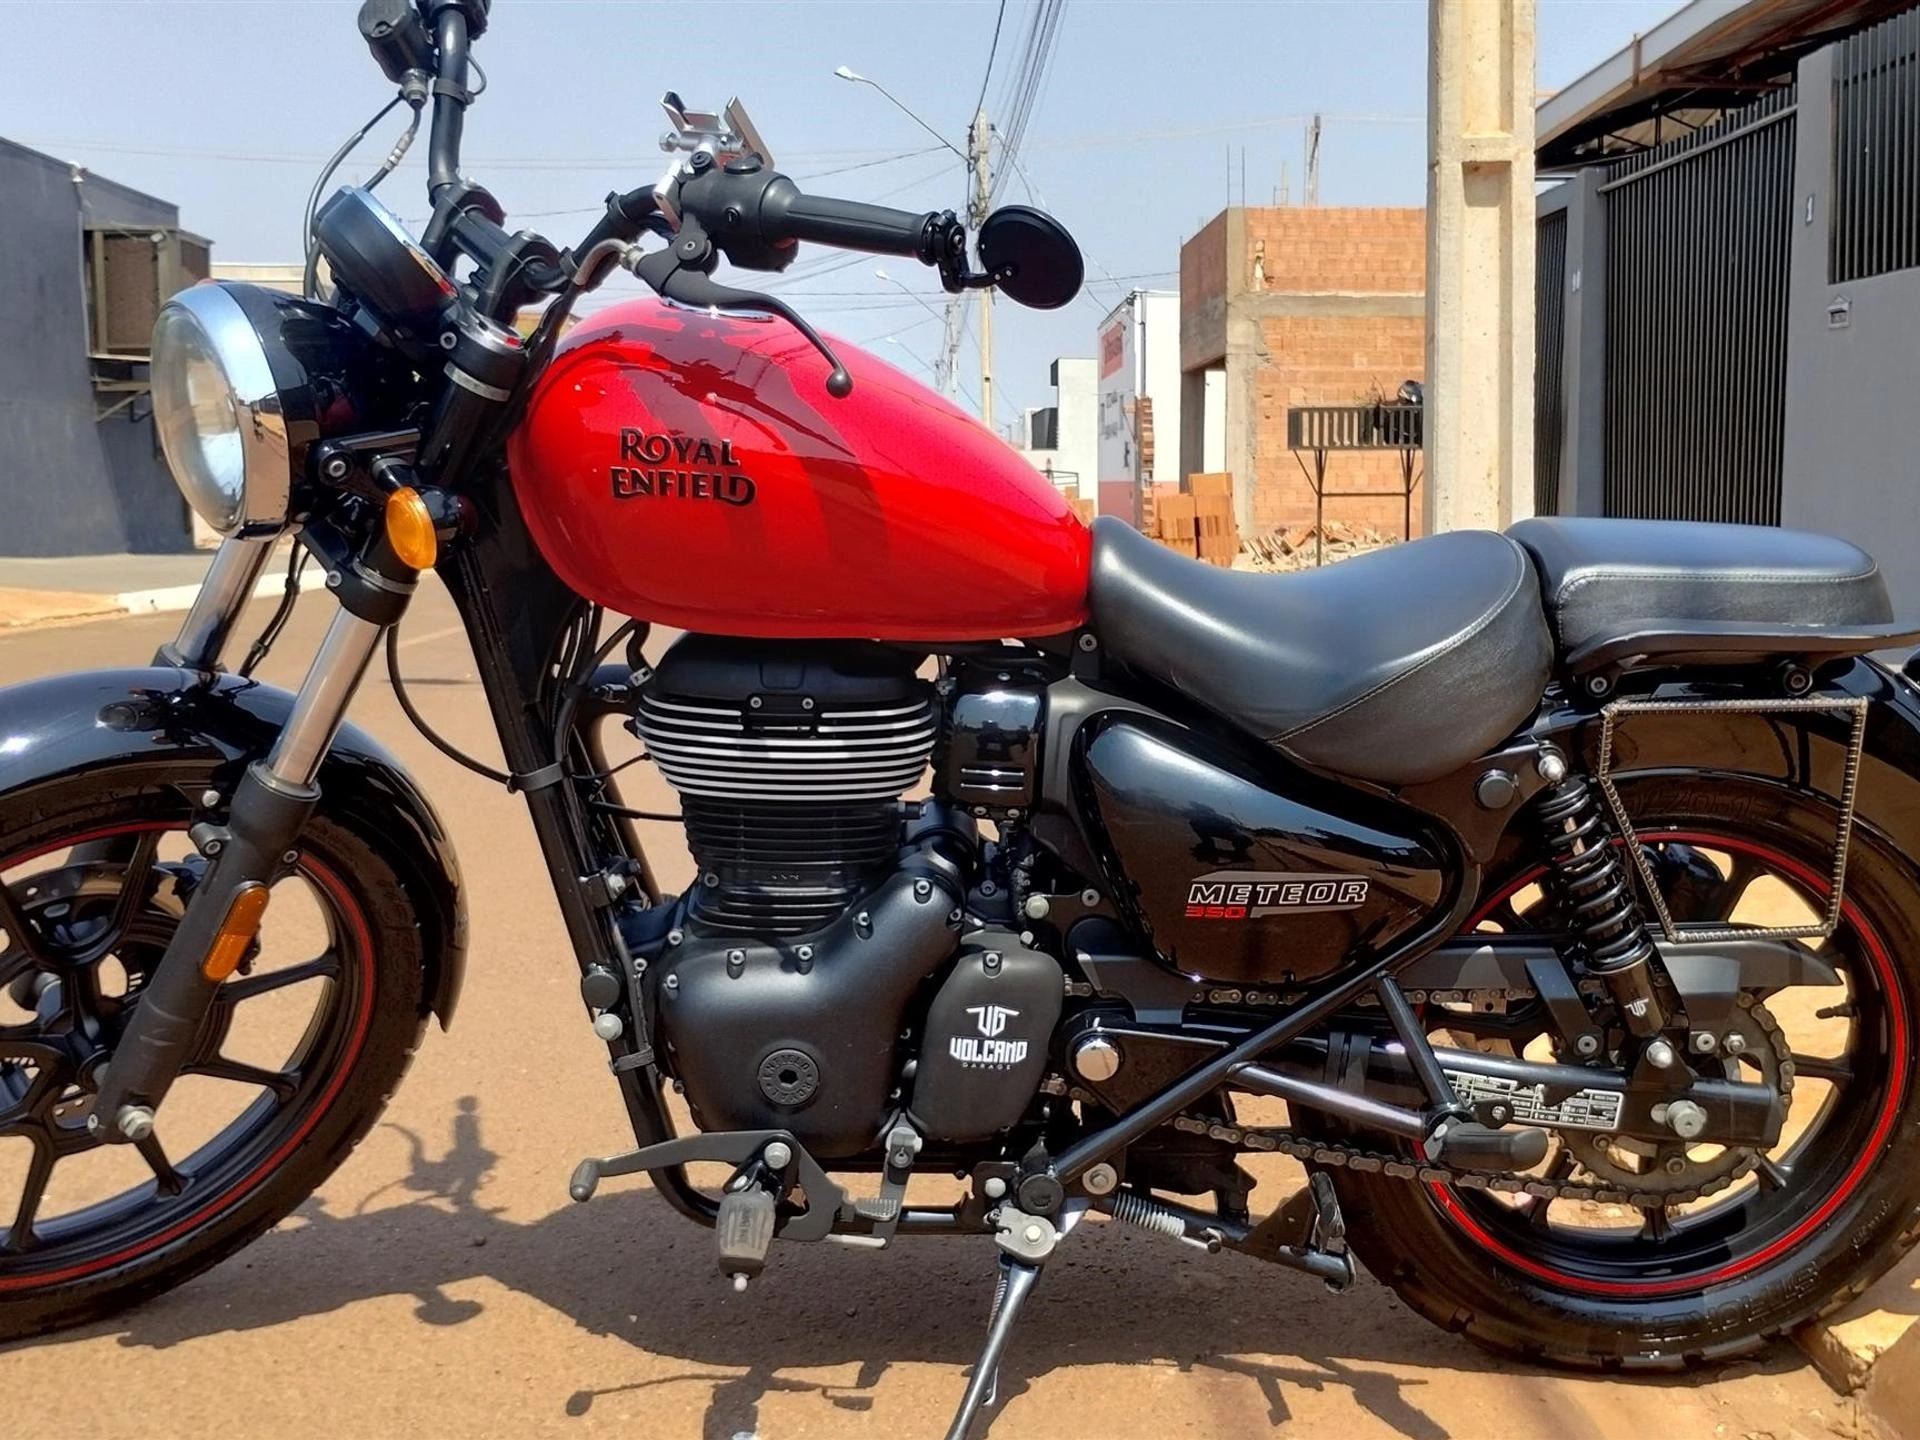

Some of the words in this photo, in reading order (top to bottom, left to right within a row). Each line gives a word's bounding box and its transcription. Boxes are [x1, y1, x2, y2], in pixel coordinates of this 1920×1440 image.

[620, 427, 741, 466] ROYAL
[610, 466, 757, 507] ENFIELD
[1187, 881, 1369, 905] METEOR
[1184, 906, 1247, 919] 350
[949, 1037, 1028, 1063] VOLCANO
